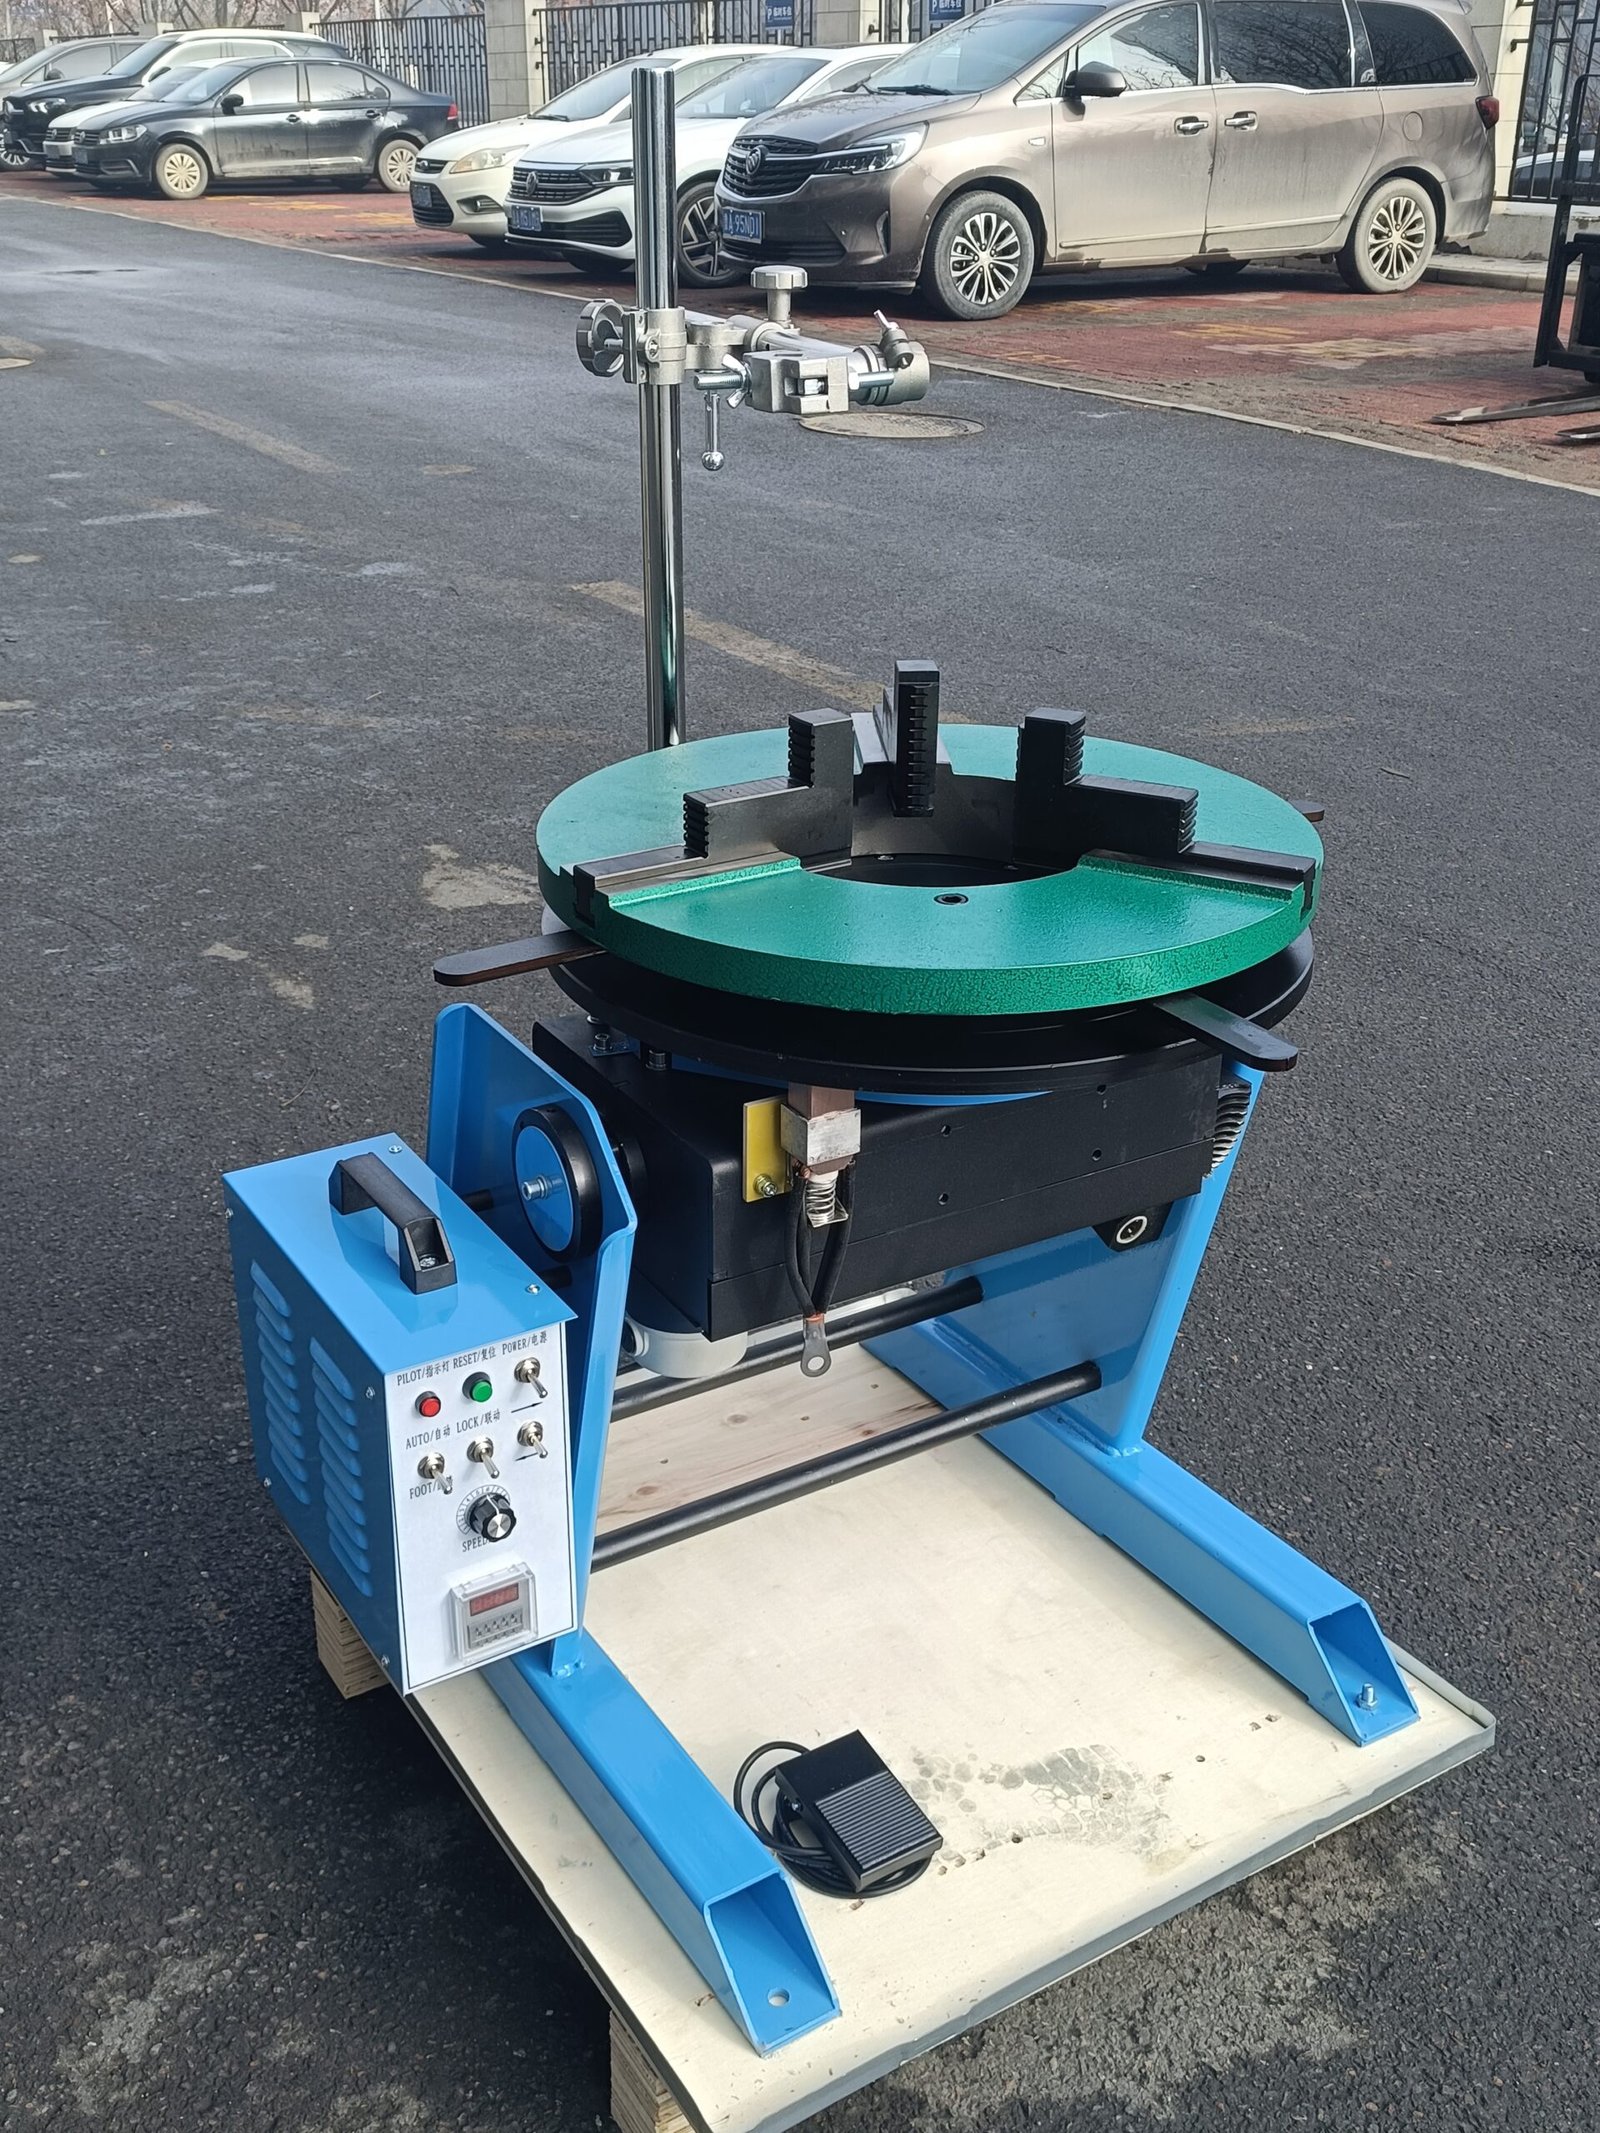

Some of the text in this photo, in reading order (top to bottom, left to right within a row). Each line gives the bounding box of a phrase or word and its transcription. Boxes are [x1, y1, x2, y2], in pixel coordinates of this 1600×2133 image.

[502, 1330, 548, 1356] POWER/电源
[453, 1346, 497, 1370] RESET/复位
[396, 1360, 450, 1387] PILOT/指示灯
[456, 1408, 501, 1434] LOCK/联动
[405, 1424, 451, 1450] AUTO/自动
[462, 1536, 491, 1553] SPEED
